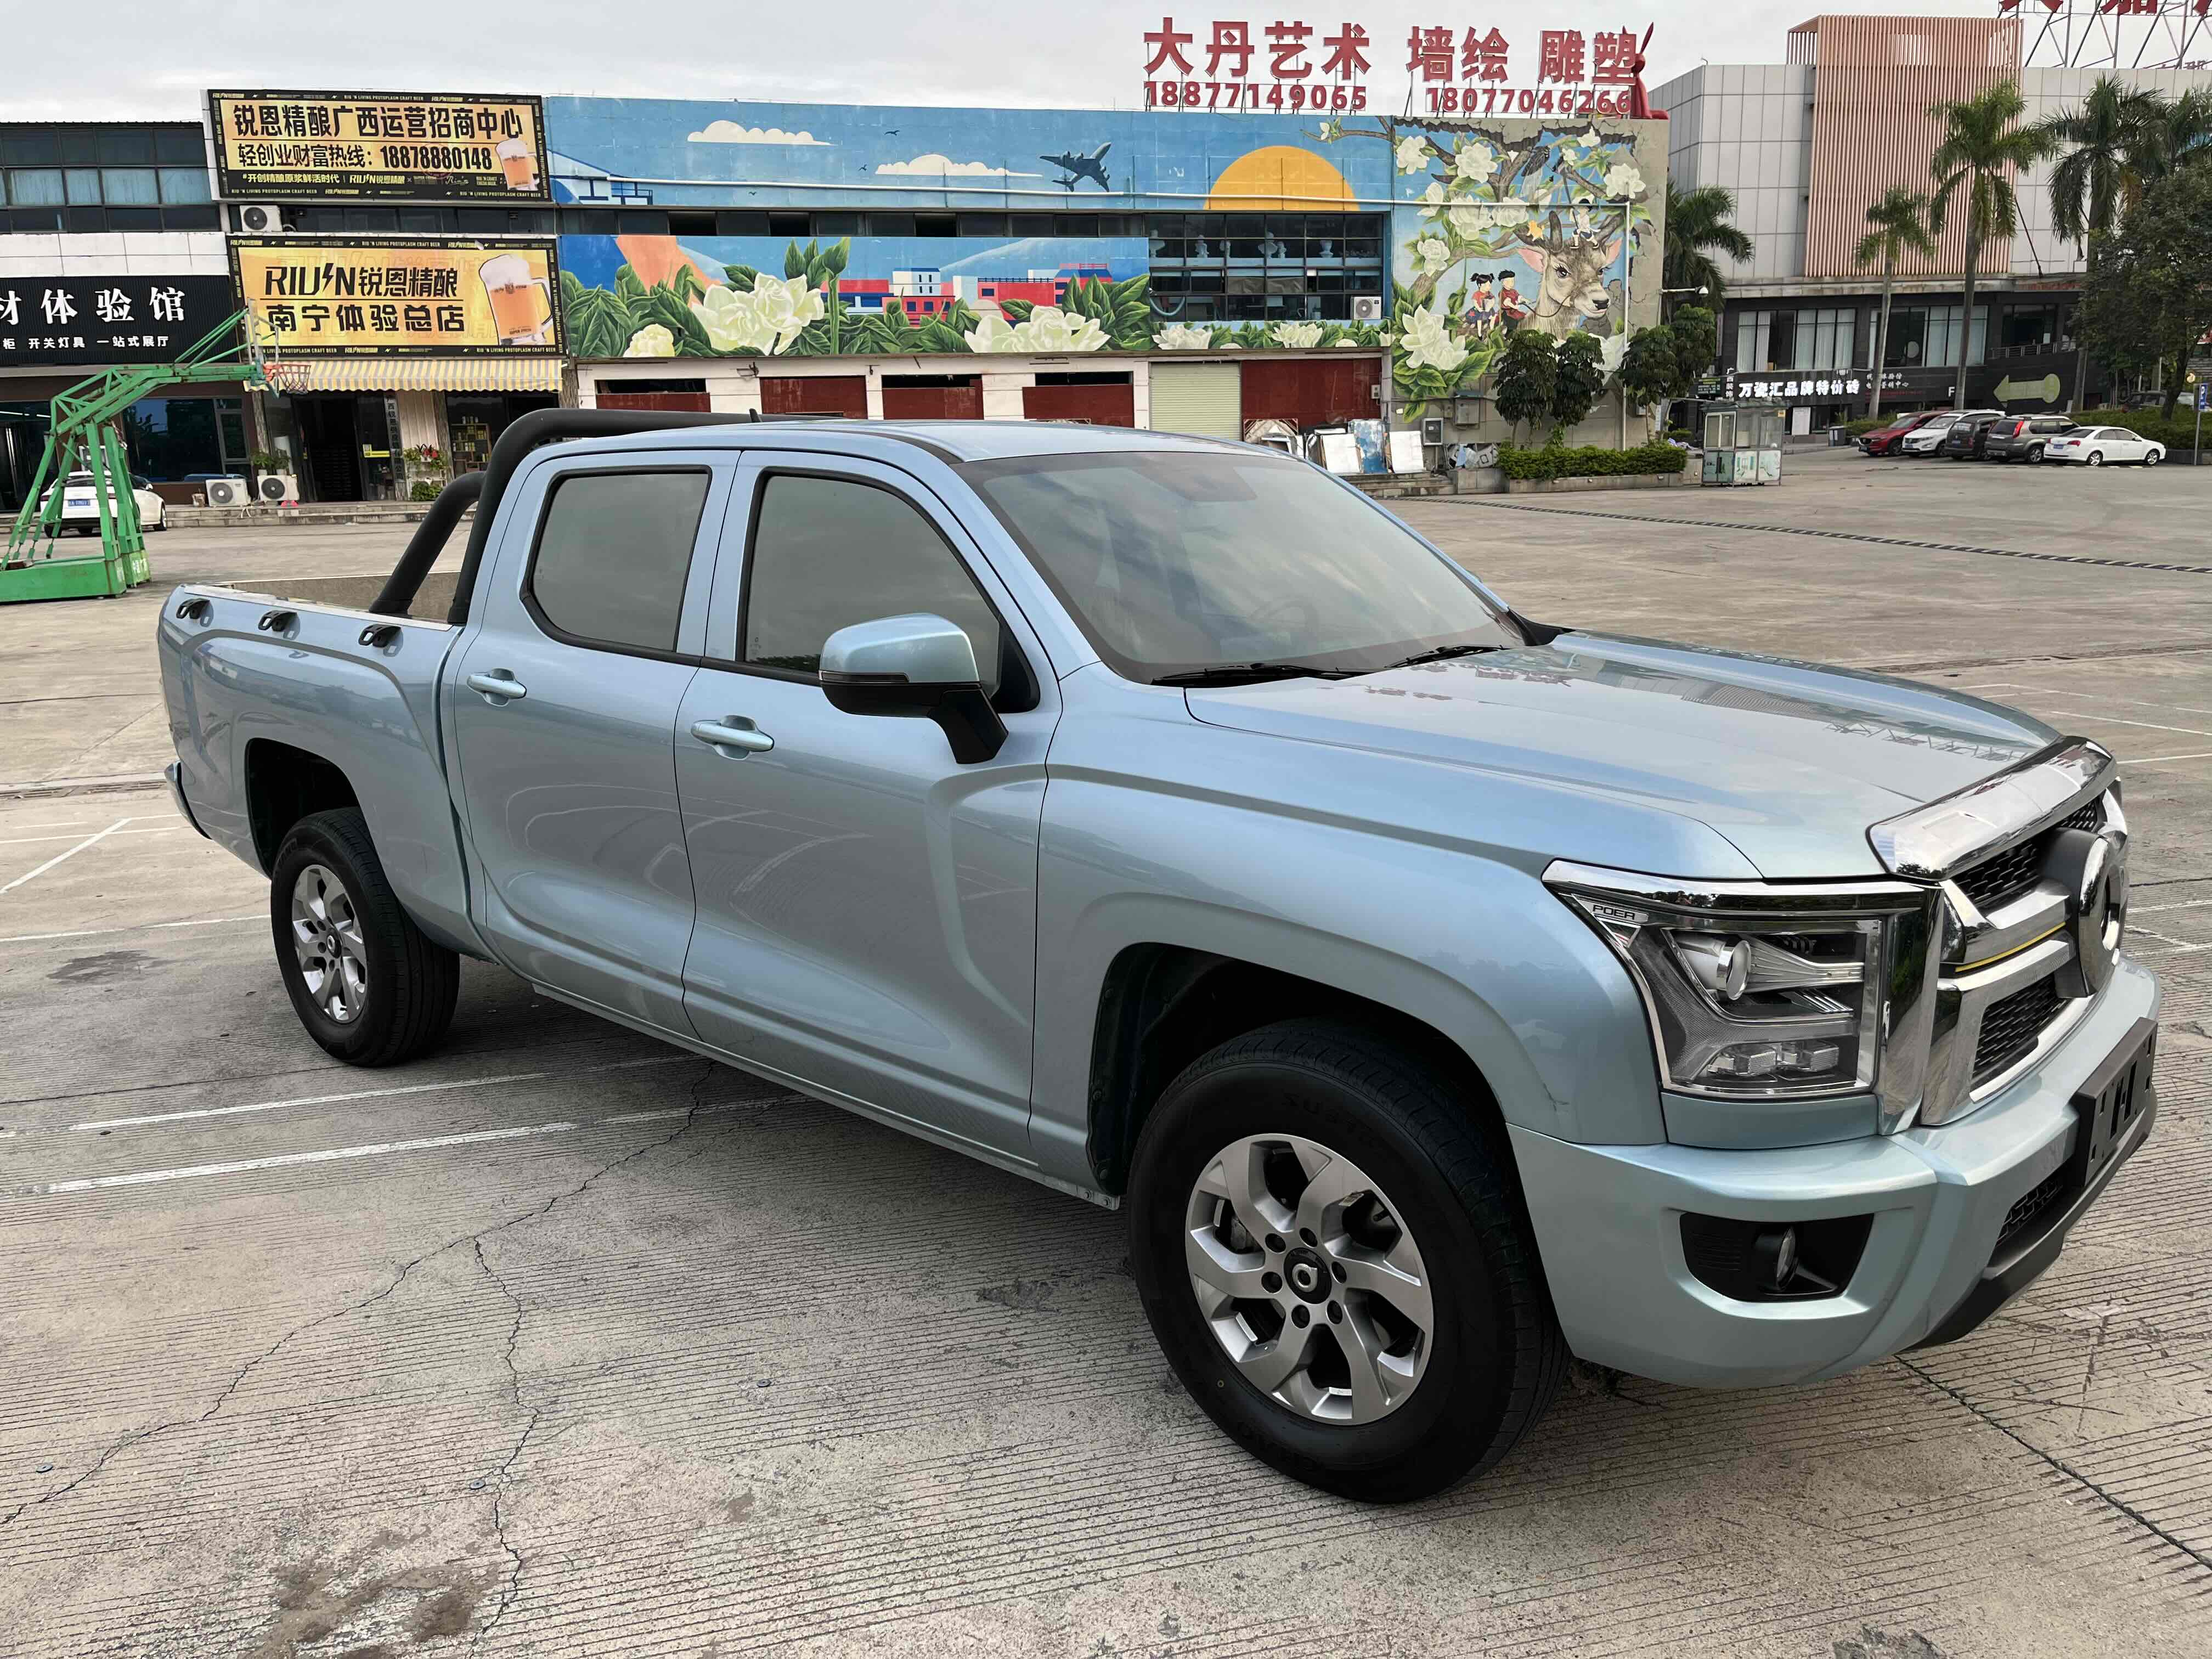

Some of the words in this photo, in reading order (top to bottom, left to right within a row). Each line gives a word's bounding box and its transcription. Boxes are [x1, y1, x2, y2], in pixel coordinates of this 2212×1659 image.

[1143, 17, 1372, 81] 大丹艺术
[1407, 26, 1509, 83] 墙绘
[1537, 29, 1637, 86] 雕塑
[1144, 81, 1367, 111] 18877149065
[1426, 87, 1631, 114] 18077046266
[233, 105, 523, 138] 锐恩精酿广西运营招商中心
[380, 146, 492, 170] 18878880148
[266, 304, 465, 332] 南宁体验总店
[3, 338, 15, 349] 柜
[29, 337, 86, 349] 开关灯具
[97, 336, 168, 347] 一站式展厅
[1738, 379, 1860, 398] 万瓷汇品牌特价砖
